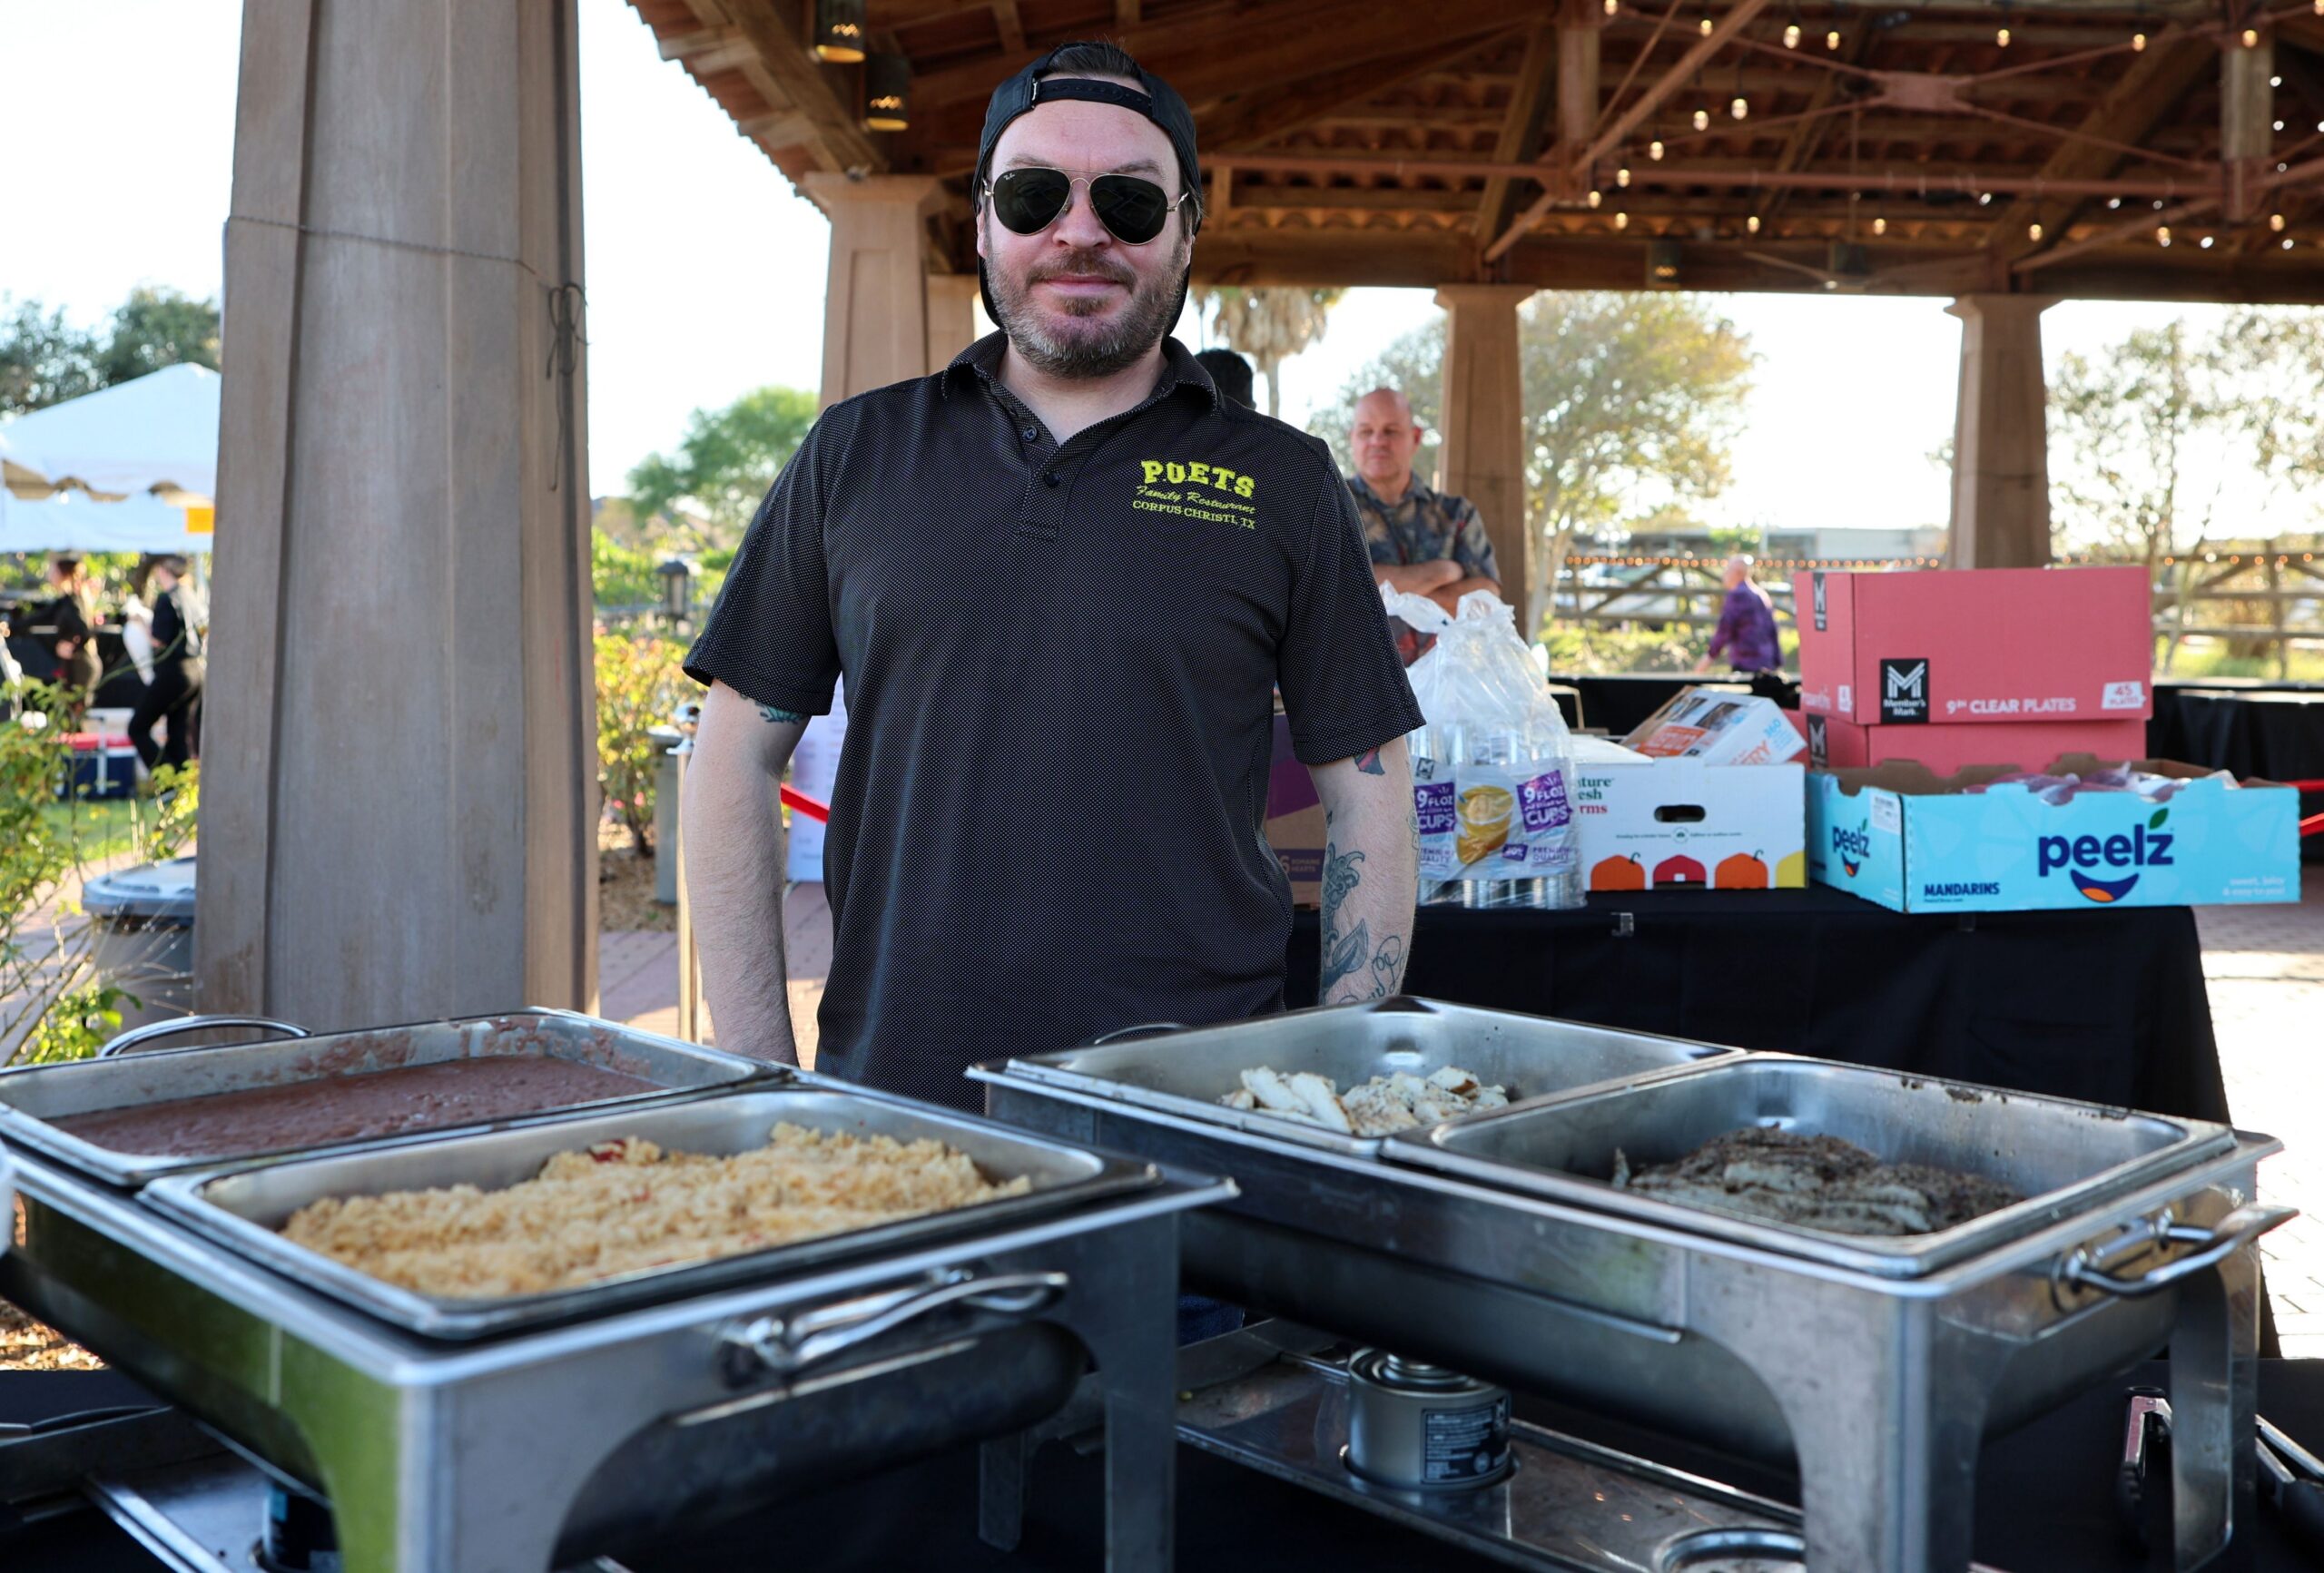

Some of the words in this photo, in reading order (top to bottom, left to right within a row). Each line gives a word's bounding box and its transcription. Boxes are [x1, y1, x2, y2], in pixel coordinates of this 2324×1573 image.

[1137, 486, 1181, 502] Family
[1187, 492, 1256, 515] Restaurant
[1133, 500, 1181, 515] CORPUS
[1241, 517, 1255, 529] TX
[1969, 698, 2020, 714] CLEAR
[2023, 697, 2076, 713] PLATES
[1417, 789, 1428, 808] 9
[1523, 787, 1536, 805] 9
[1418, 814, 1454, 830] CUPS
[1525, 805, 1570, 826] CUPS
[1832, 825, 1870, 859] peelz
[2039, 824, 2174, 877] peelz
[1924, 882, 2000, 897] MANDARINS
